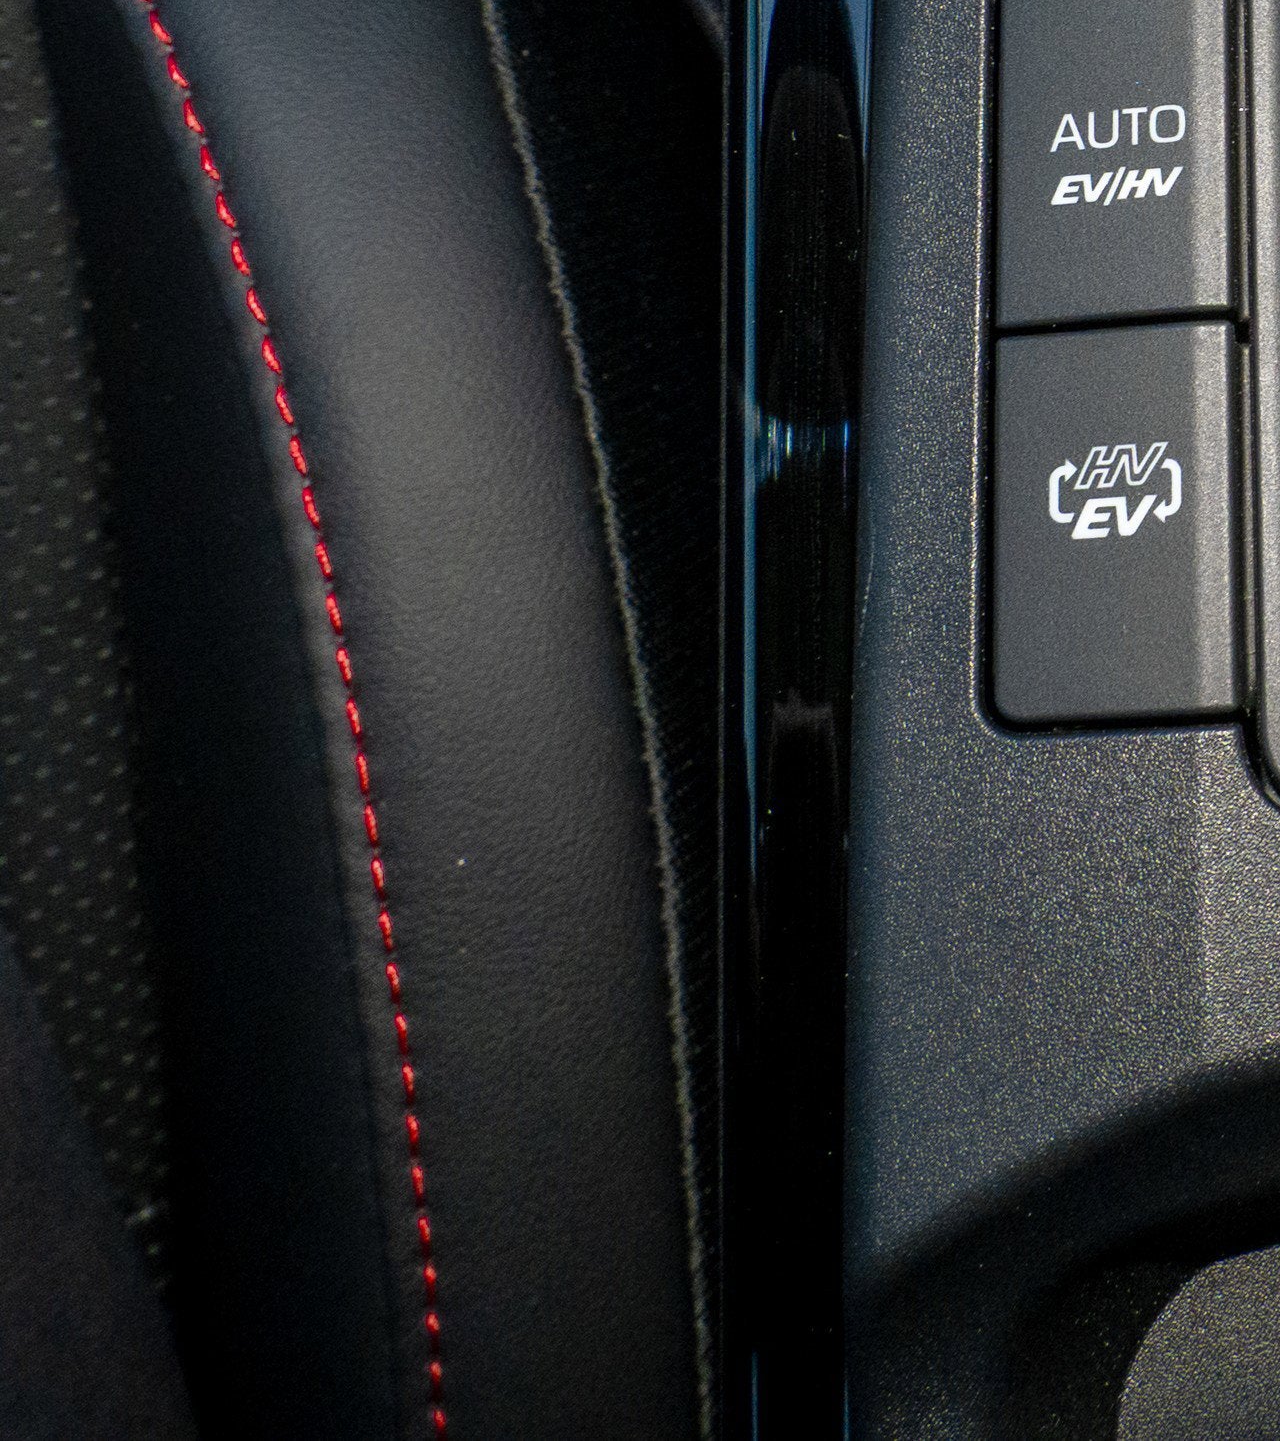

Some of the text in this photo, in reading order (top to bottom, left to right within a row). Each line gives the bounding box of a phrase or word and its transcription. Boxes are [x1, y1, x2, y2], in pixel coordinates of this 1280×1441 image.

[1050, 103, 1187, 153] AUTO
[1050, 166, 1183, 206] EV/HV
[1073, 441, 1169, 490] HV
[1071, 495, 1158, 540] EV
